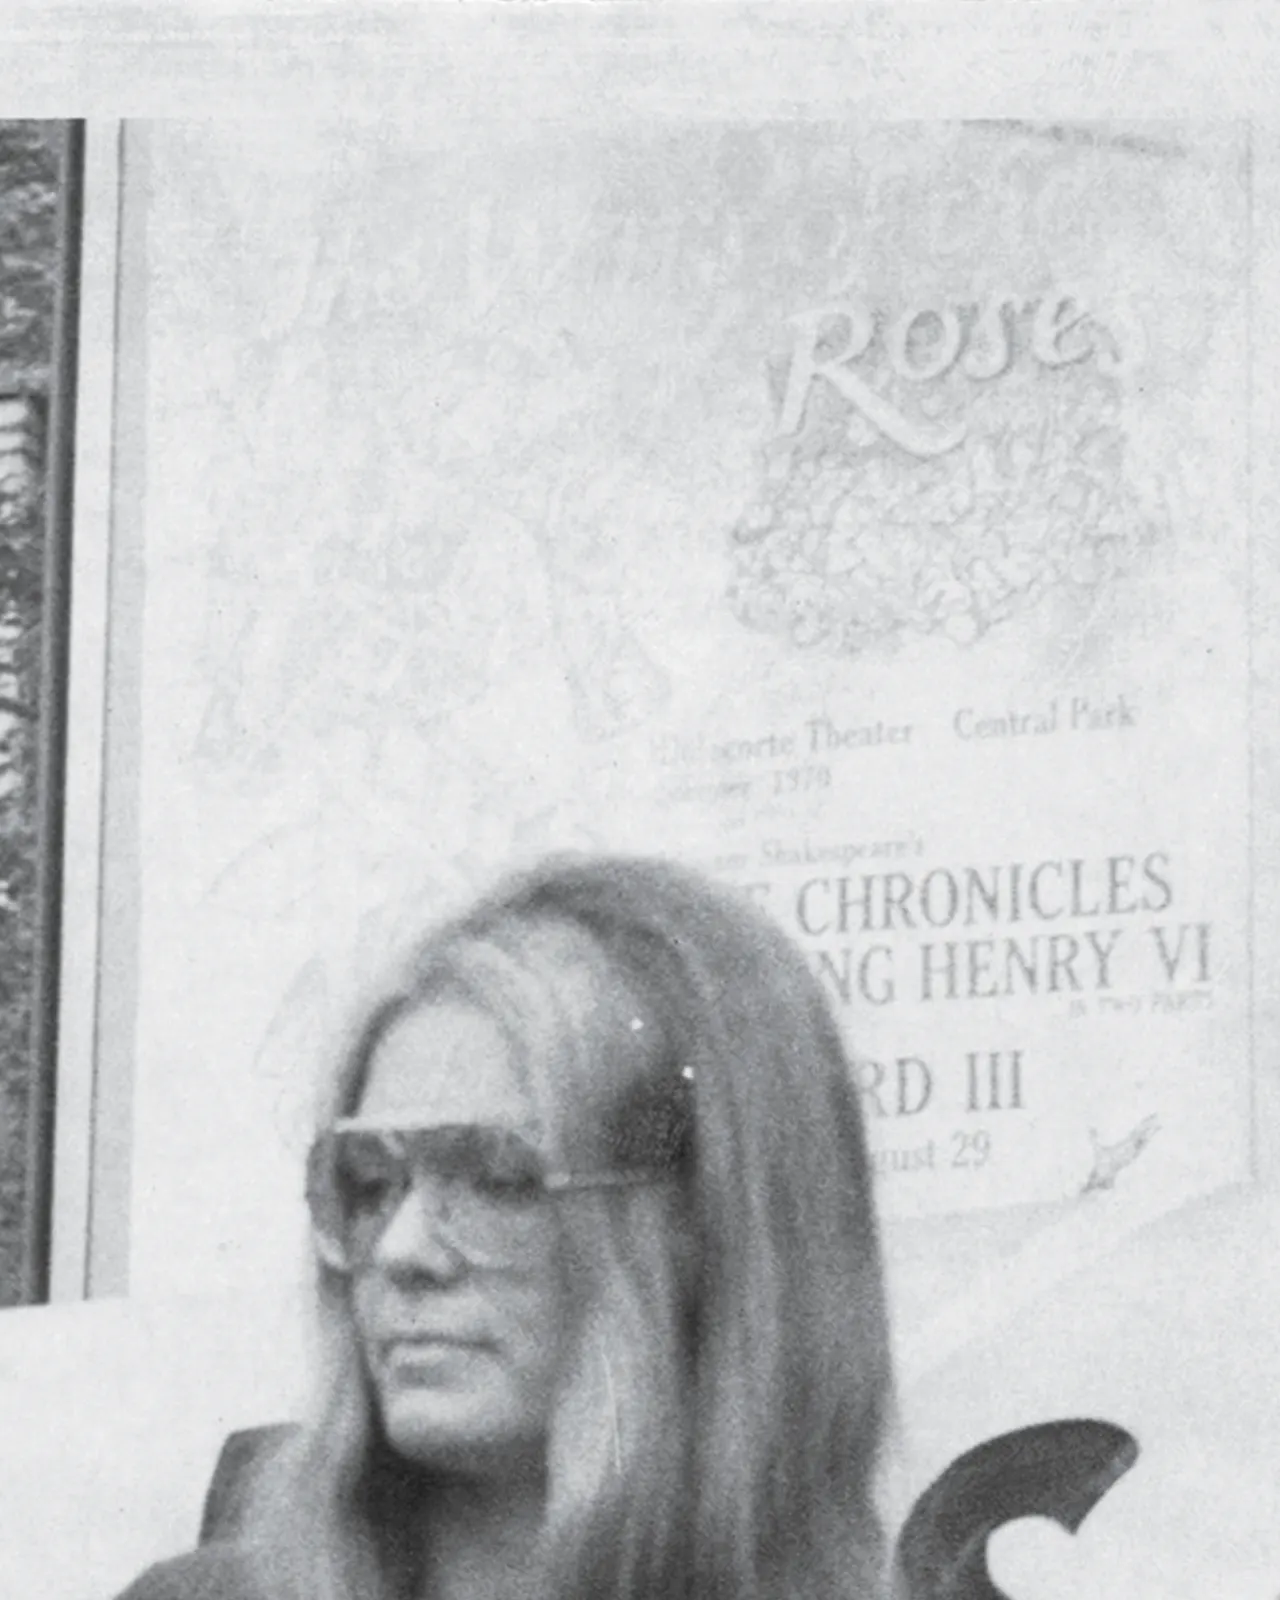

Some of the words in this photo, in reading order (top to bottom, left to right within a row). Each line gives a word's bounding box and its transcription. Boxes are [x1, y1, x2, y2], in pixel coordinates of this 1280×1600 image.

[770, 294, 1148, 455] Roses
[805, 715, 914, 756] Theater
[953, 698, 1058, 741] Central
[1070, 693, 1139, 731] Park
[772, 765, 832, 796] 1970
[795, 852, 1173, 936] CHRONICLES
[918, 928, 1123, 1002] HENRY
[1152, 921, 1214, 985] VI
[963, 1049, 1026, 1114] III
[951, 1129, 992, 1170] 29
